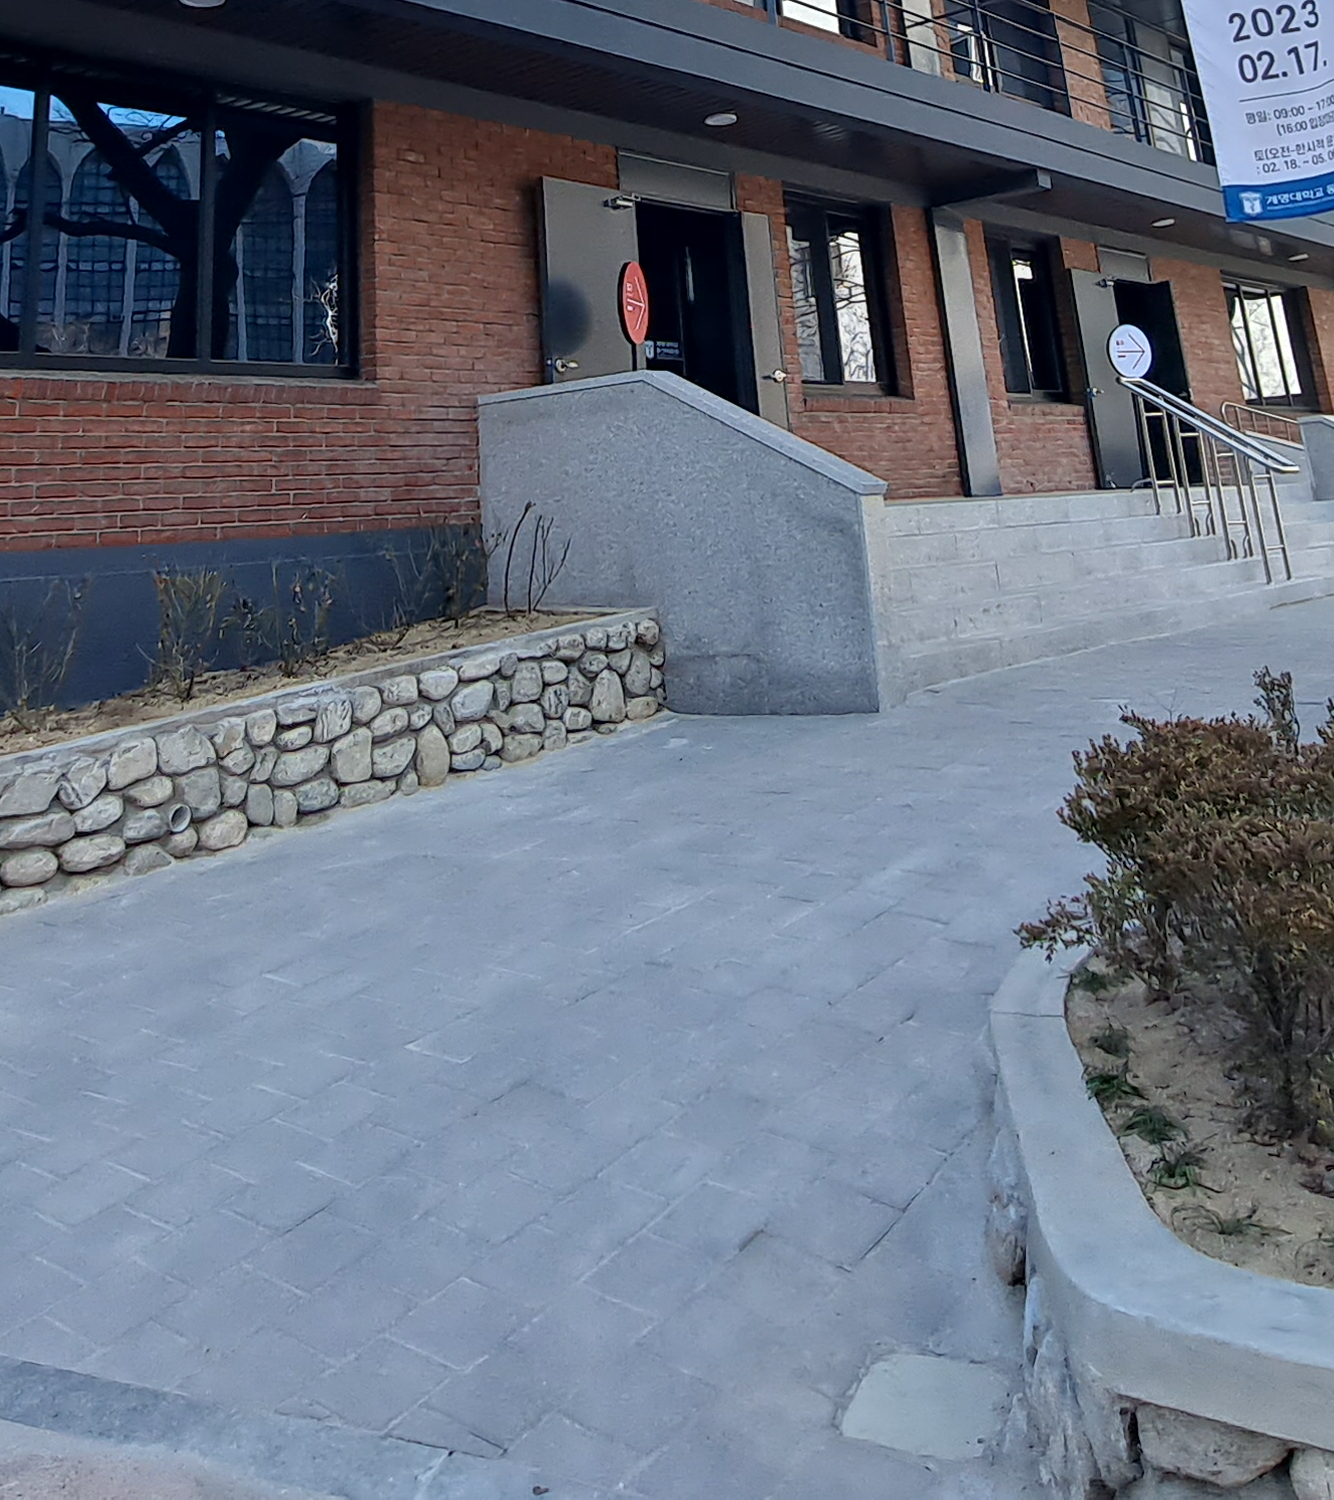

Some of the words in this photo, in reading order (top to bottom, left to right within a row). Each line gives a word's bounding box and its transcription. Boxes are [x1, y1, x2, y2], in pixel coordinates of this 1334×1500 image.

[1228, 0, 1319, 42] 2023
[1238, 40, 1327, 83] 02.17.
[1273, 105, 1305, 120] 09:00
